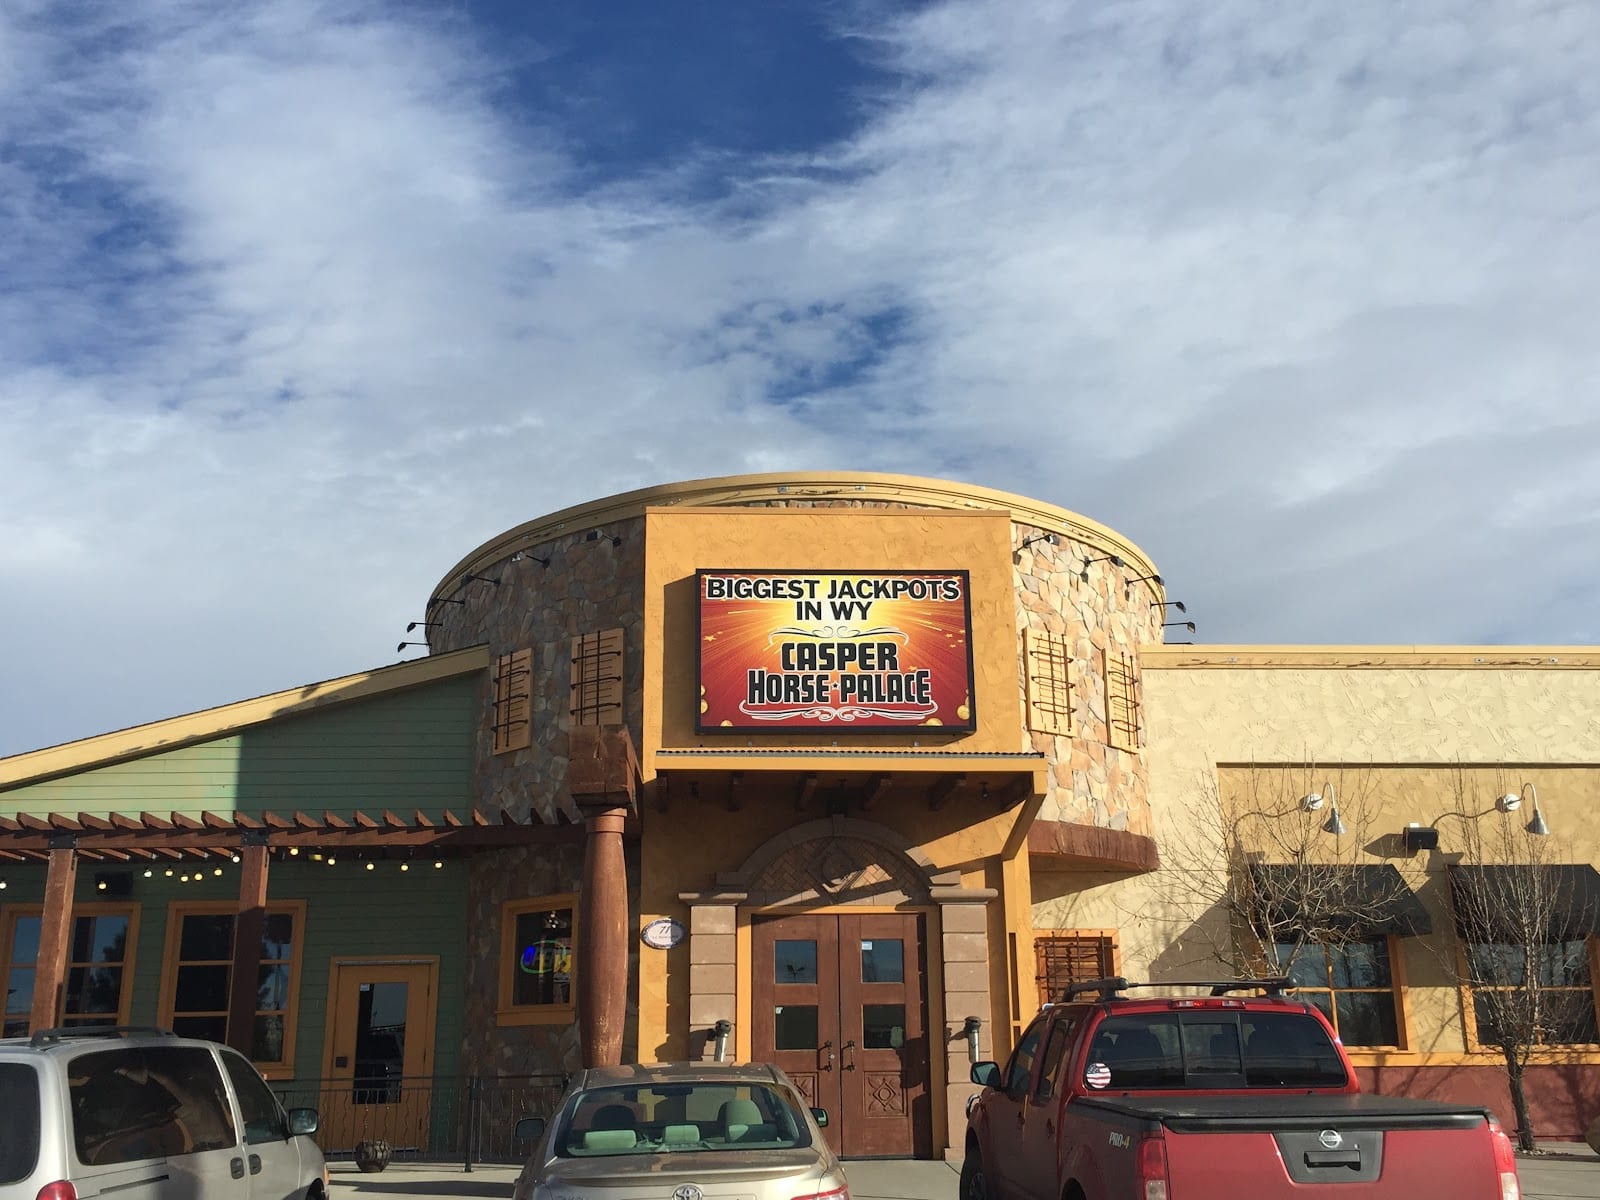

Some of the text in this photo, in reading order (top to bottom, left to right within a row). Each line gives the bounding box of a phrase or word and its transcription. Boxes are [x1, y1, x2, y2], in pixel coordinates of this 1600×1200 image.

[706, 577, 960, 600] BIGGEST JACKPOTS
[796, 601, 872, 621] IN WY
[781, 642, 898, 671] CASPER
[747, 669, 931, 704] HORSE PALACE
